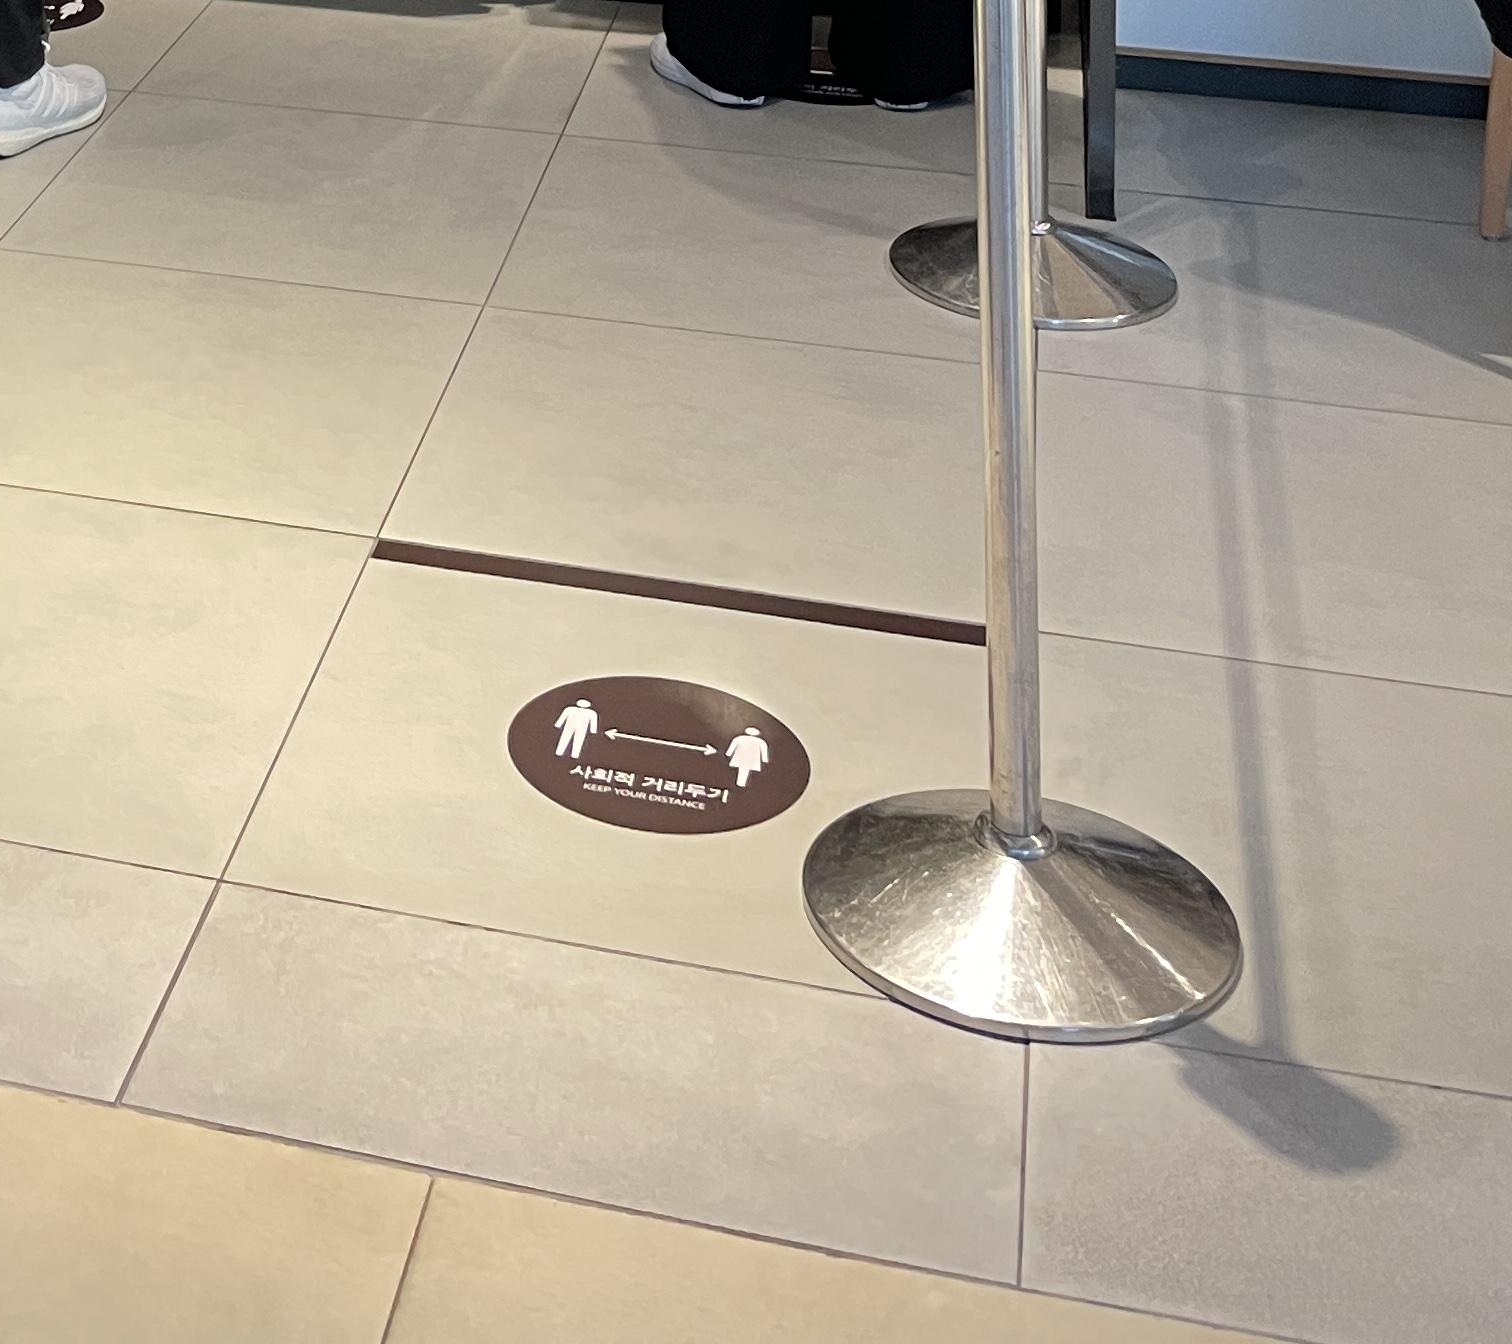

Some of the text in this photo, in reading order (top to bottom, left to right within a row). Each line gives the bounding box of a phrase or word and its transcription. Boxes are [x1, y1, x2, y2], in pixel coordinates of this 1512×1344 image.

[570, 765, 729, 803] 사회적 거리두기
[583, 783, 706, 810] KEEP YOUR DISTANCE
